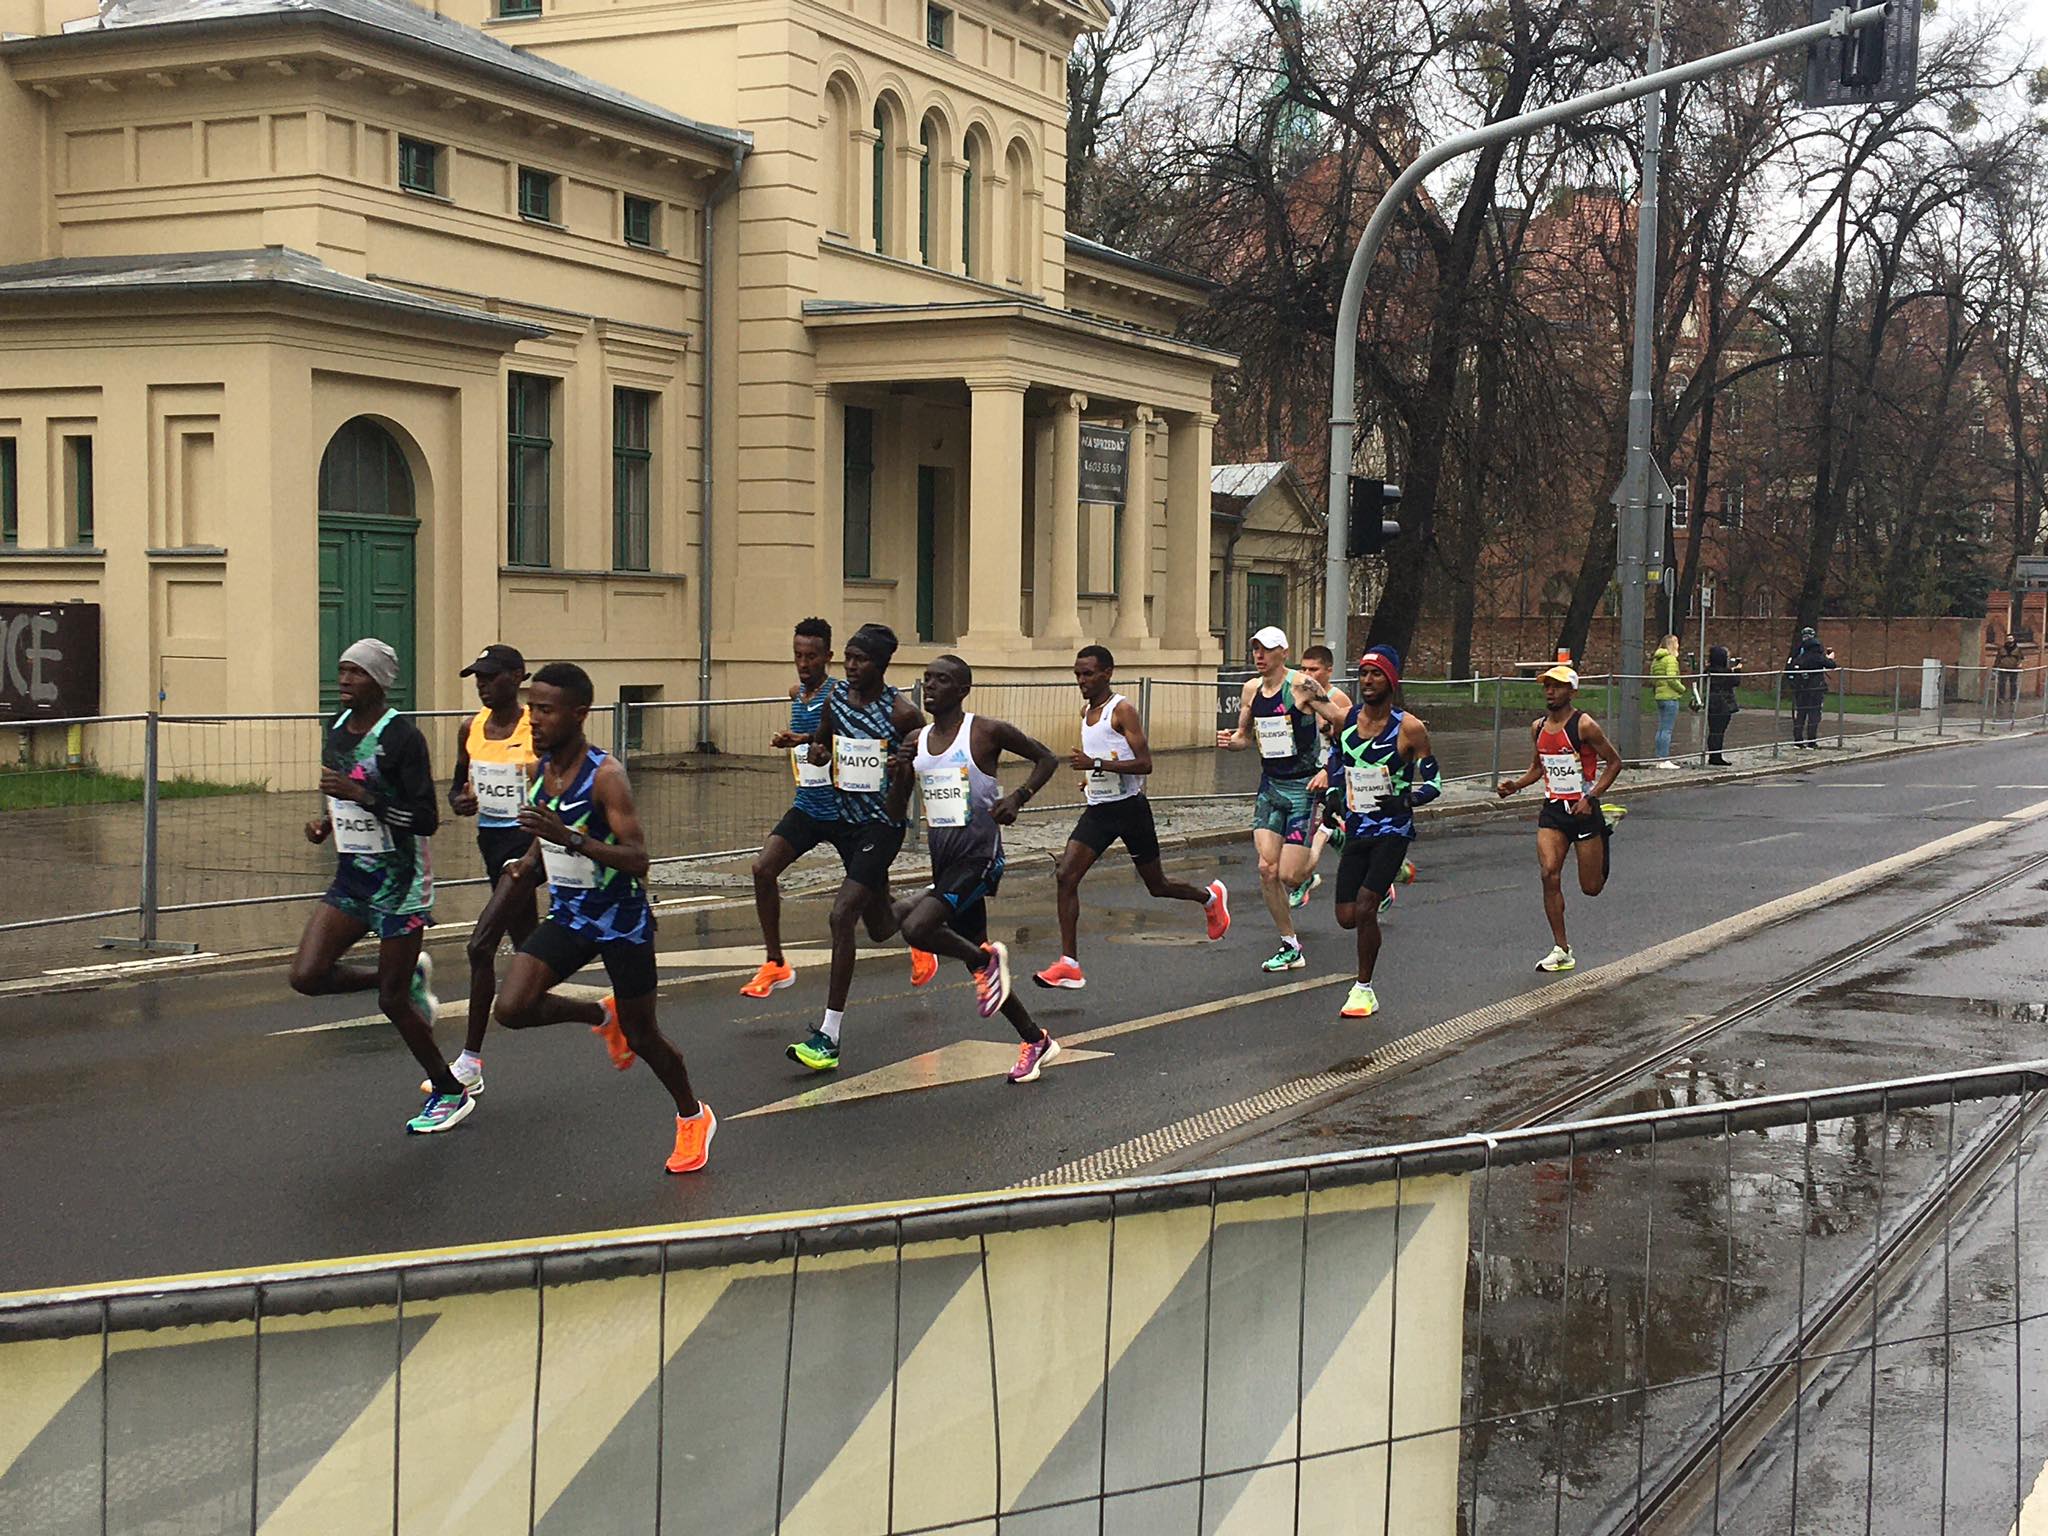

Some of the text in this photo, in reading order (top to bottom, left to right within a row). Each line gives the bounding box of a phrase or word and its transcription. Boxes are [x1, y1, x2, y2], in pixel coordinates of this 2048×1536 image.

[840, 754, 880, 768] MAIYO
[1547, 766, 1576, 777] 7054
[477, 782, 515, 797] PACE
[924, 787, 961, 800] CHESIR
[336, 817, 376, 832] PACE
